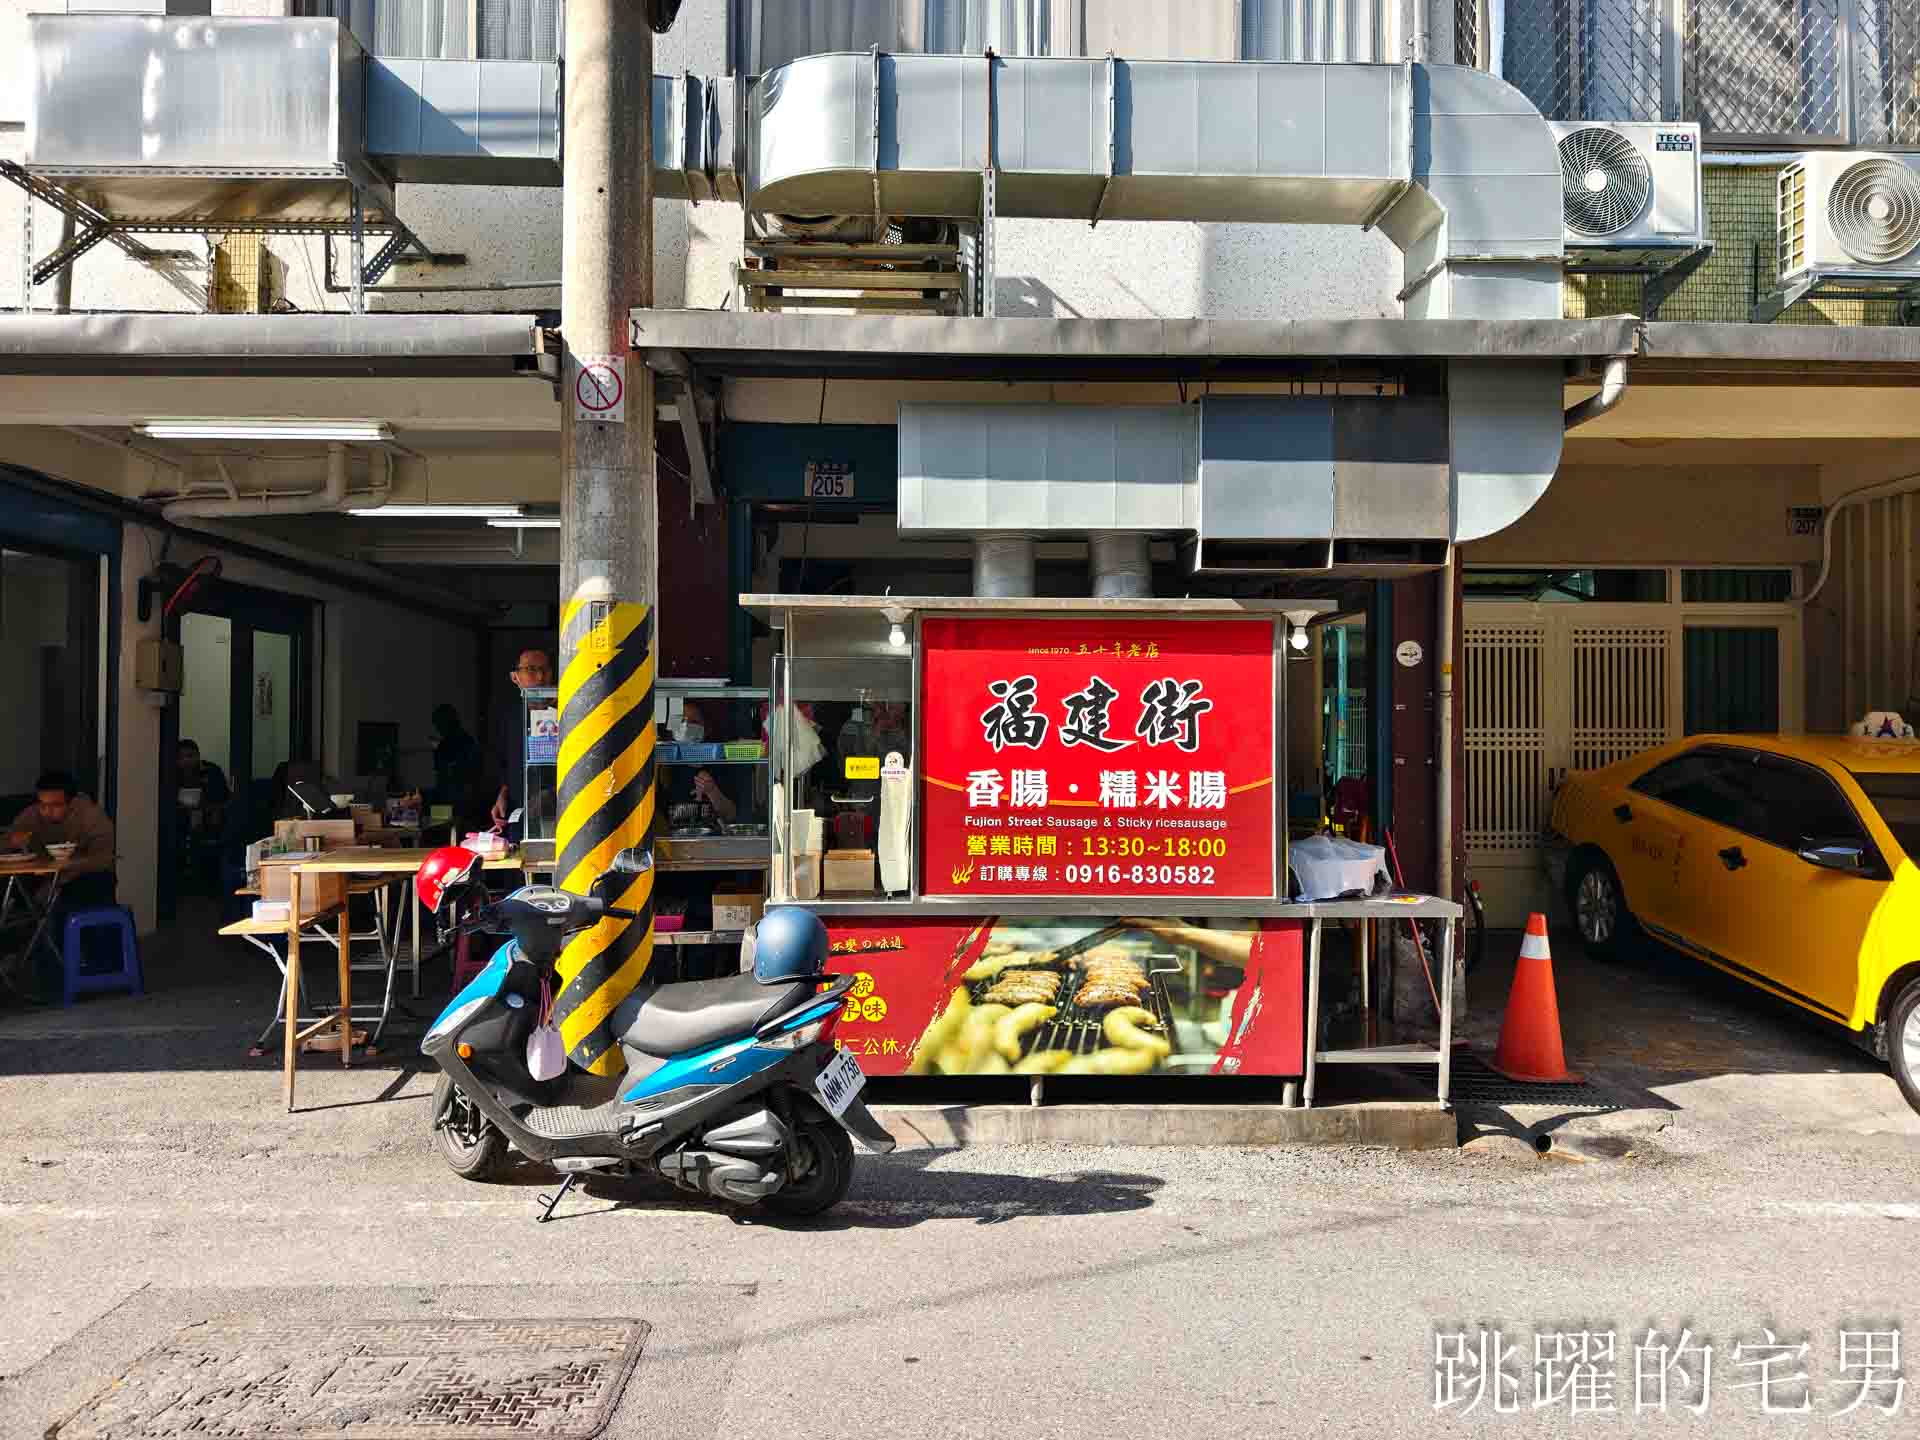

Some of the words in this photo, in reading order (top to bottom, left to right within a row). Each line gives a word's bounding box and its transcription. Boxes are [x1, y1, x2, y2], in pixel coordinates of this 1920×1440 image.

[1658, 134, 1690, 142] TECO
[814, 475, 844, 496] 205
[1050, 646, 1070, 655] 1970
[1075, 640, 1160, 658] 五十年老店
[980, 675, 1213, 753] 福建街
[964, 815, 1002, 828] Fujian
[1007, 816, 1043, 828] Street
[1046, 816, 1098, 829] Sausage
[1103, 817, 1112, 828] &
[1117, 816, 1153, 830] Sticky
[1155, 816, 1227, 829] ricesausage
[1065, 865, 1215, 885] 0916-830582
